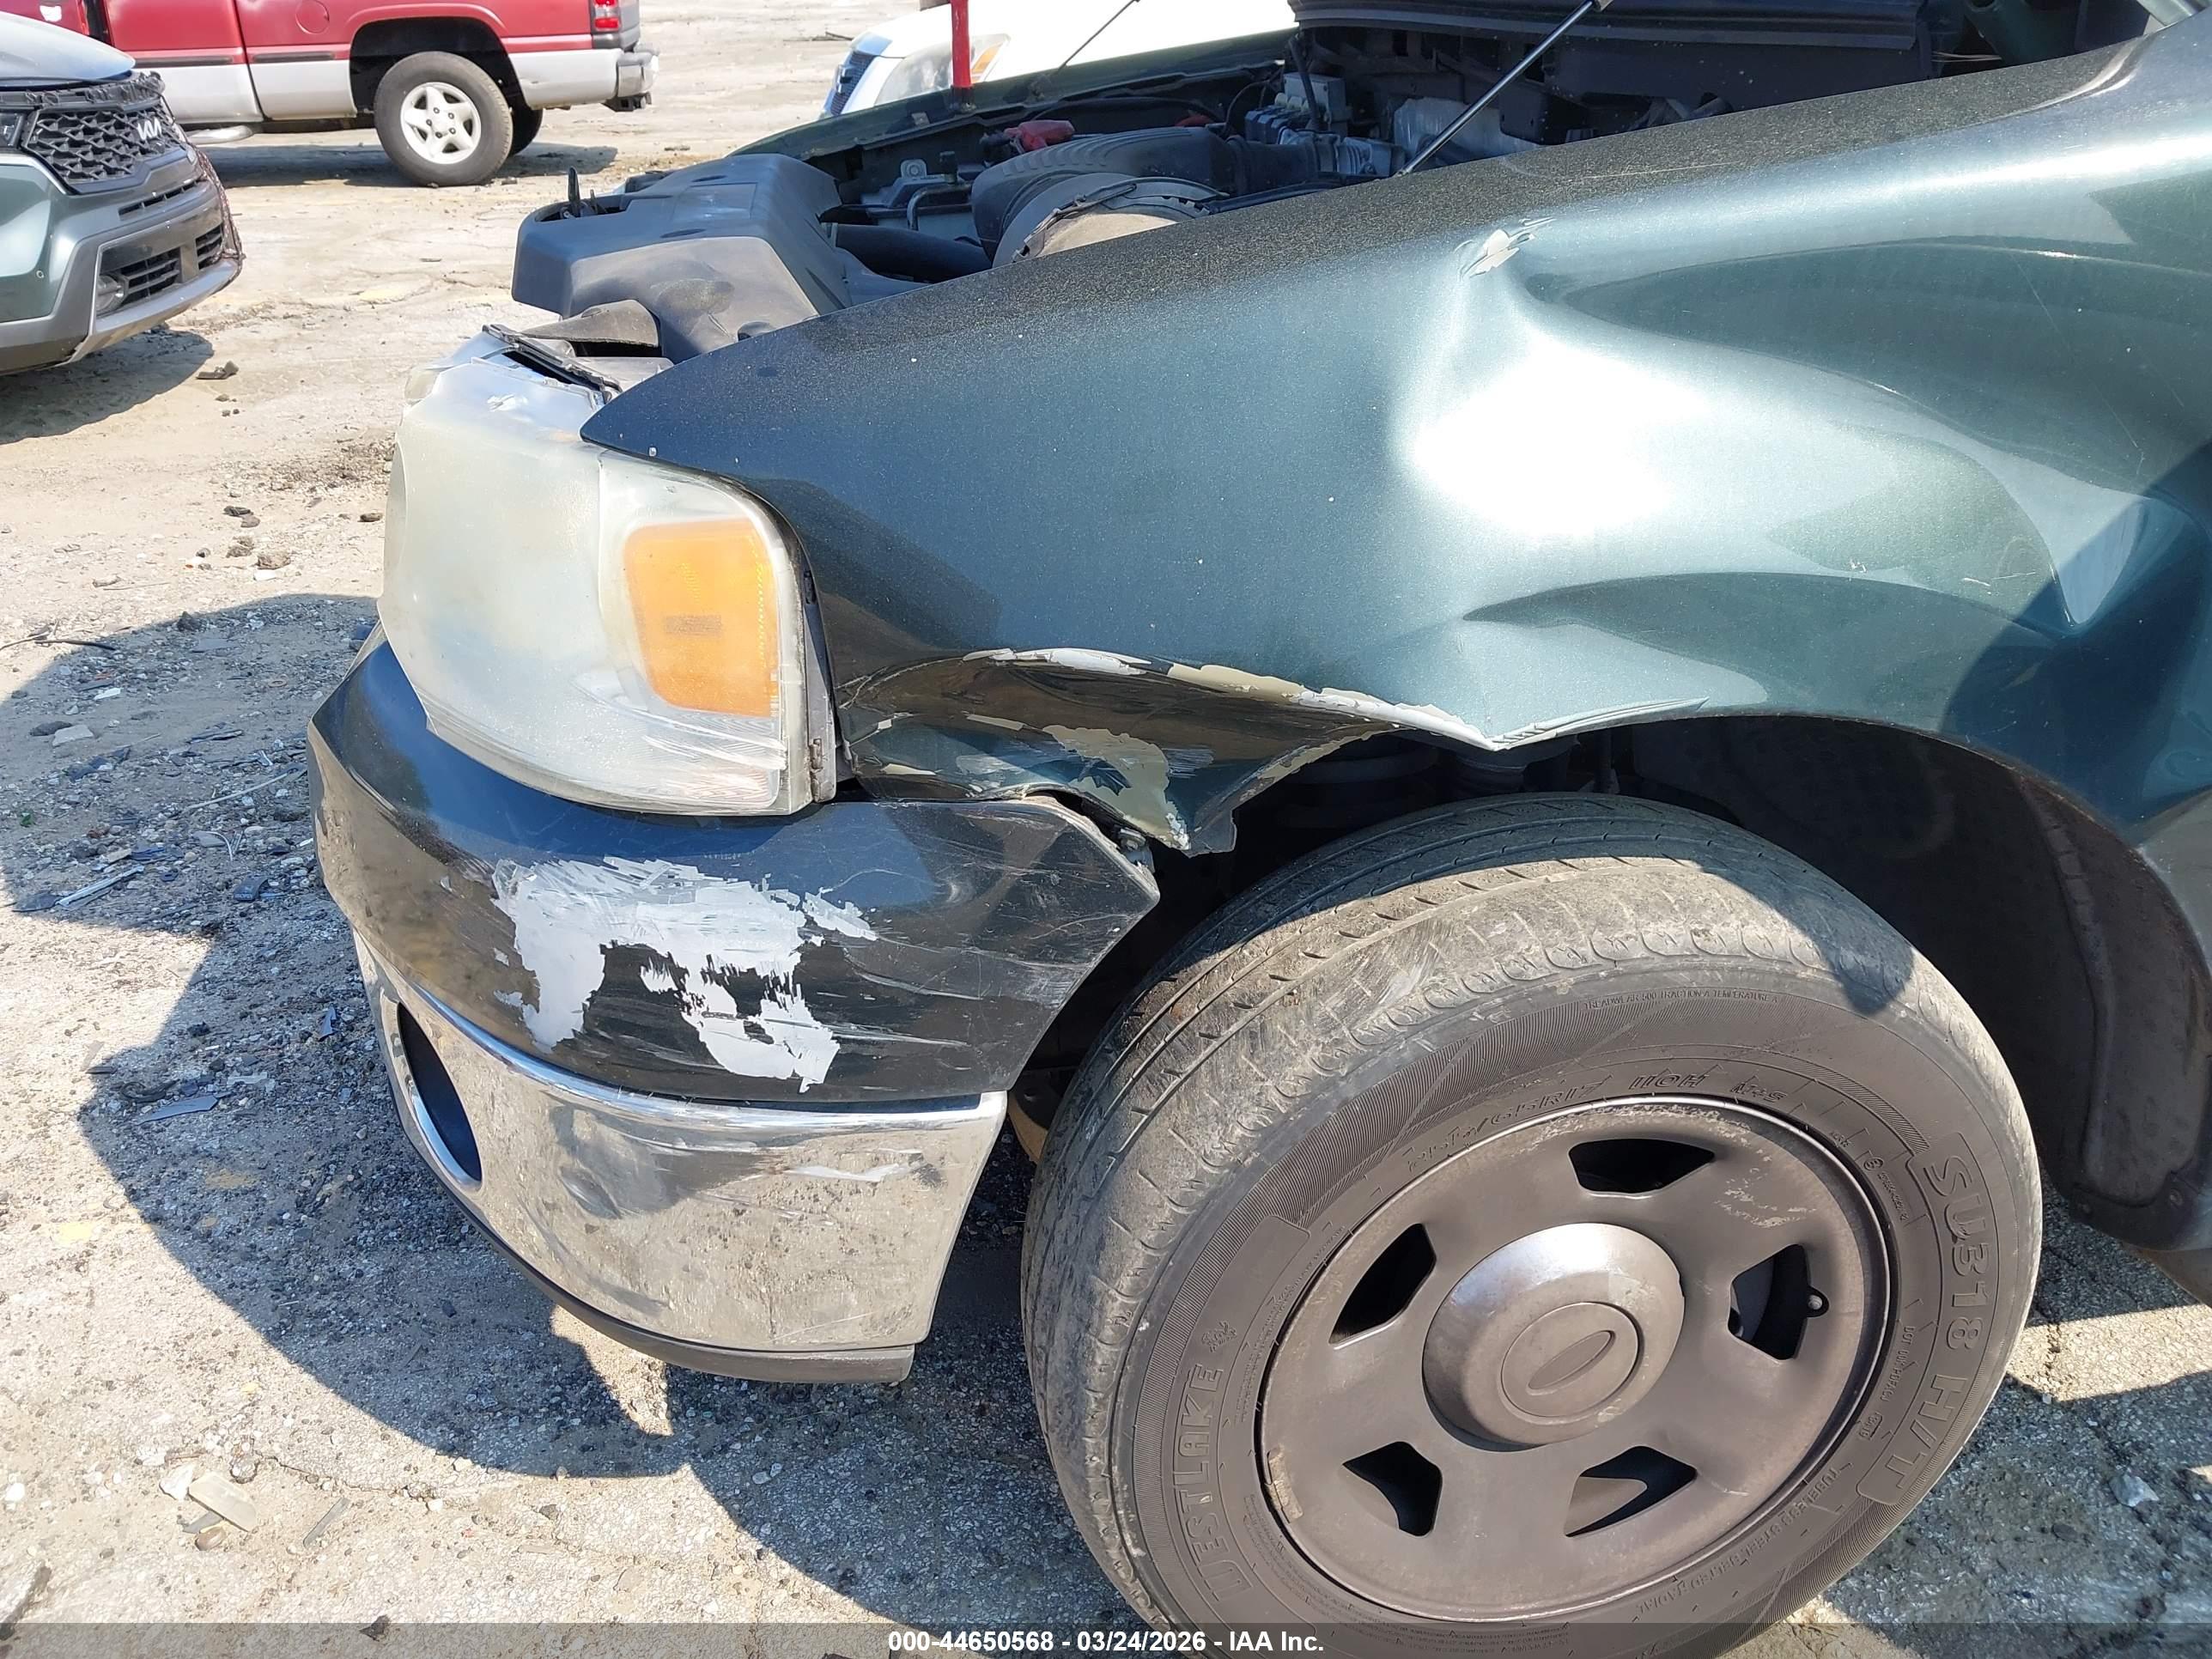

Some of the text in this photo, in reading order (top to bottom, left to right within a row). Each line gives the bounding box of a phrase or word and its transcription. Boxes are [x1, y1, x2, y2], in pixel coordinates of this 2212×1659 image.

[1661, 989, 1701, 1000] TRACTION
[1713, 989, 1771, 1004] TEMPERATURE
[1884, 1155, 1990, 1490] SU318 H/T
[1173, 1363, 1254, 1602] WESTLAKE
